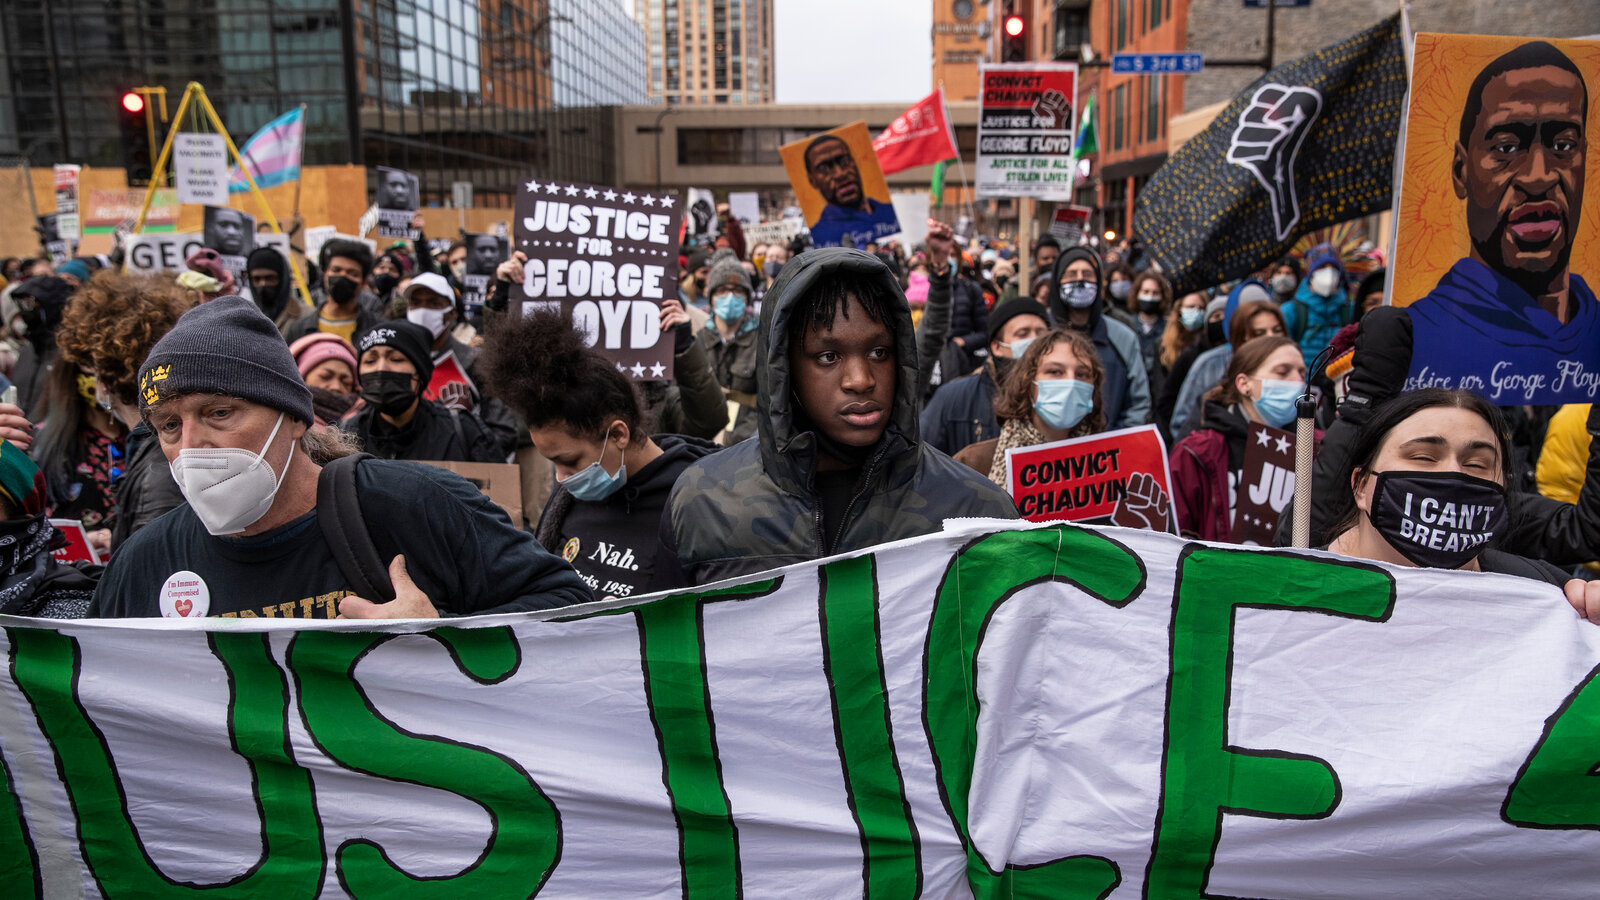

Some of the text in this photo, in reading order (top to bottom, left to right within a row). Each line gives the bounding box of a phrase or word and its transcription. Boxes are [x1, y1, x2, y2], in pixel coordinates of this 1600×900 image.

[1133, 56, 1144, 69] S
[1151, 56, 1178, 69] 3rd
[1182, 56, 1200, 69] St
[986, 76, 1043, 88] CONVICT
[983, 115, 1056, 128] JUSTICE FOR
[981, 137, 1070, 152] GEORGE FLOYD
[990, 158, 1069, 169] JUSTICE FOR ALL
[1006, 172, 1069, 183] STOLEN LIVES
[522, 199, 671, 245] JUSTICE
[577, 236, 613, 257] FOR
[522, 258, 665, 299] GEORGE
[521, 300, 662, 350] OYD
[1490, 360, 1546, 399] George
[1551, 359, 1600, 398] Floy
[1019, 448, 1121, 488] CONVICT
[1018, 476, 1129, 517] CHAUVIN
[1404, 492, 1495, 531] I CAN'T
[588, 541, 639, 571] Nah.
[167, 588, 200, 598] Compromised
[178, 580, 199, 588] Immune
[602, 580, 634, 597] 1955
[0, 525, 1394, 900] USTICE
